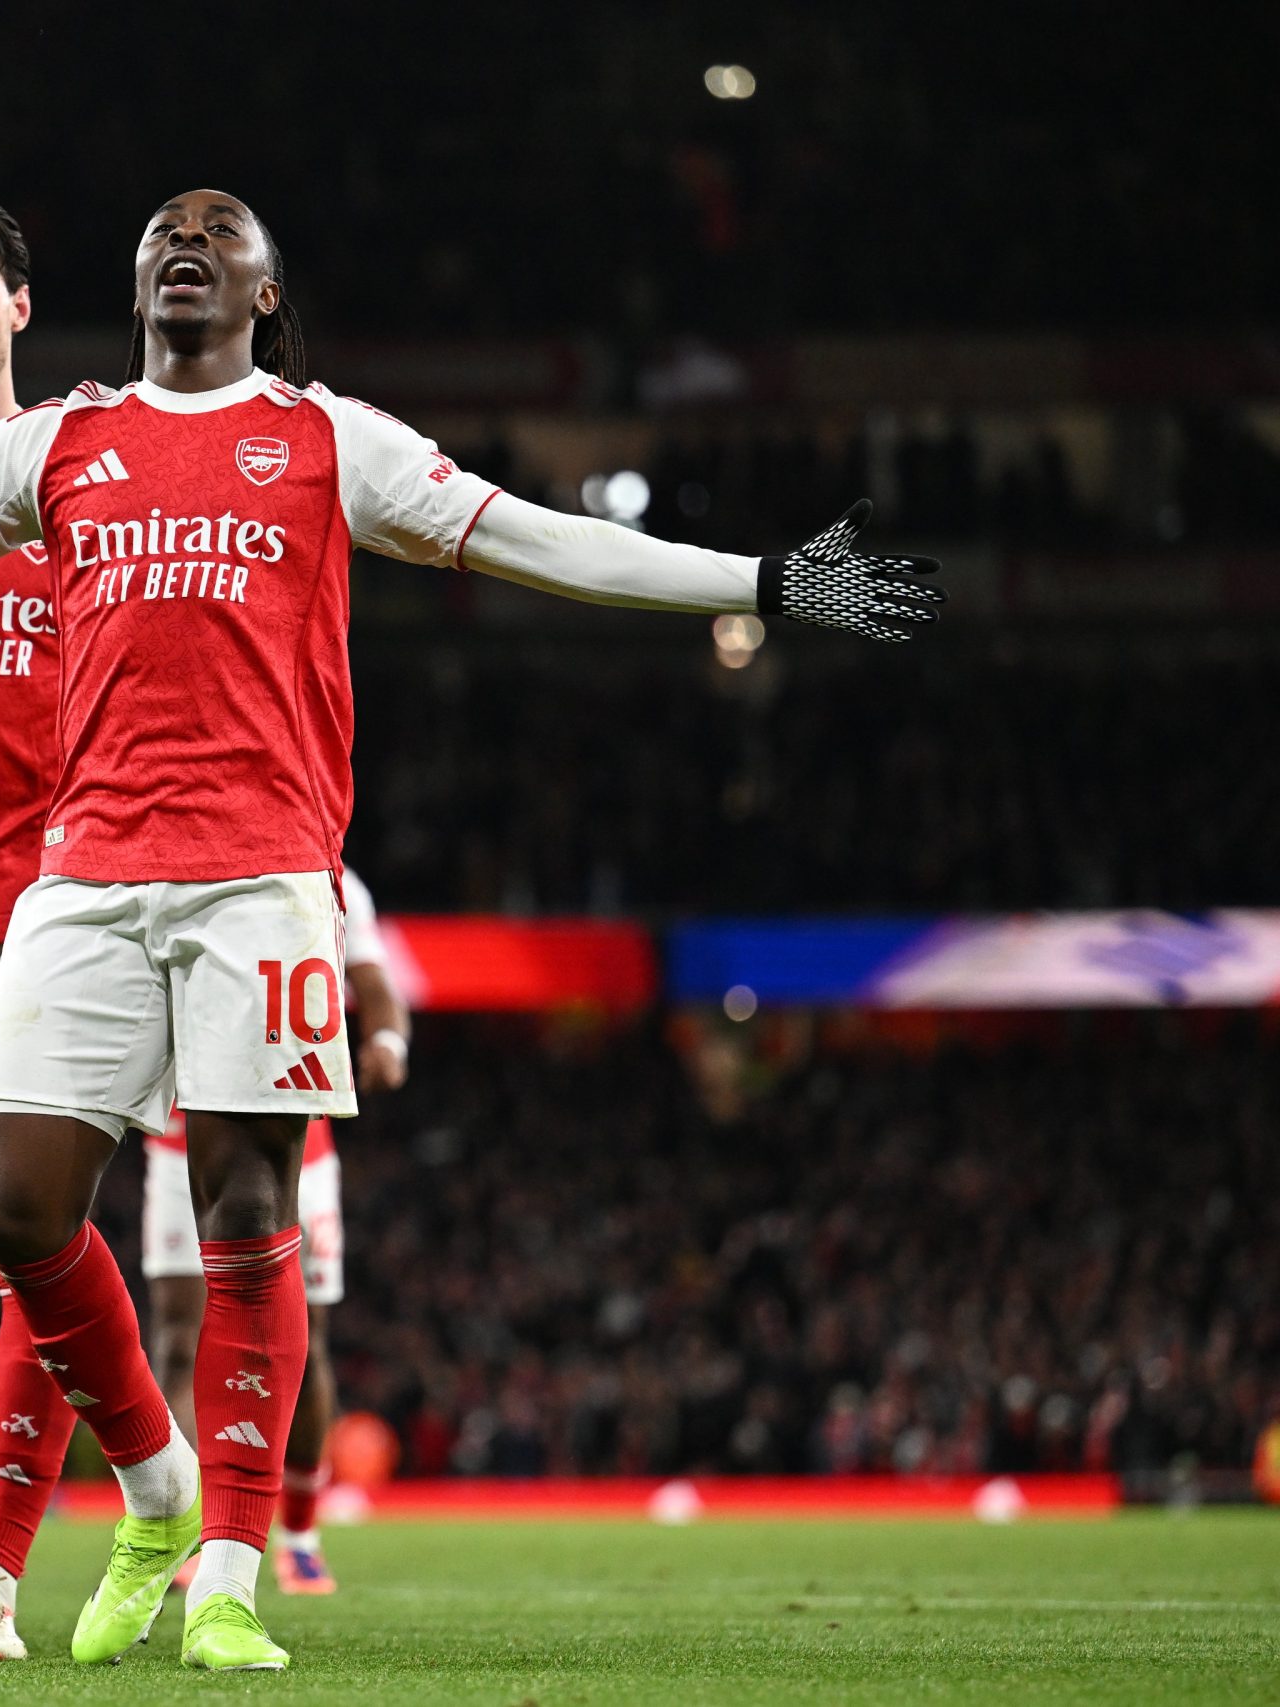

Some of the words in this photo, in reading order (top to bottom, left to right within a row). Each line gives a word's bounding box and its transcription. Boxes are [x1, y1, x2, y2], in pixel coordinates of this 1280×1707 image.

[244, 444, 282, 455] Arsenal
[68, 507, 286, 569] Emirates
[95, 568, 136, 607] FLY
[144, 561, 249, 603] BETTER
[258, 957, 340, 1045] 10
